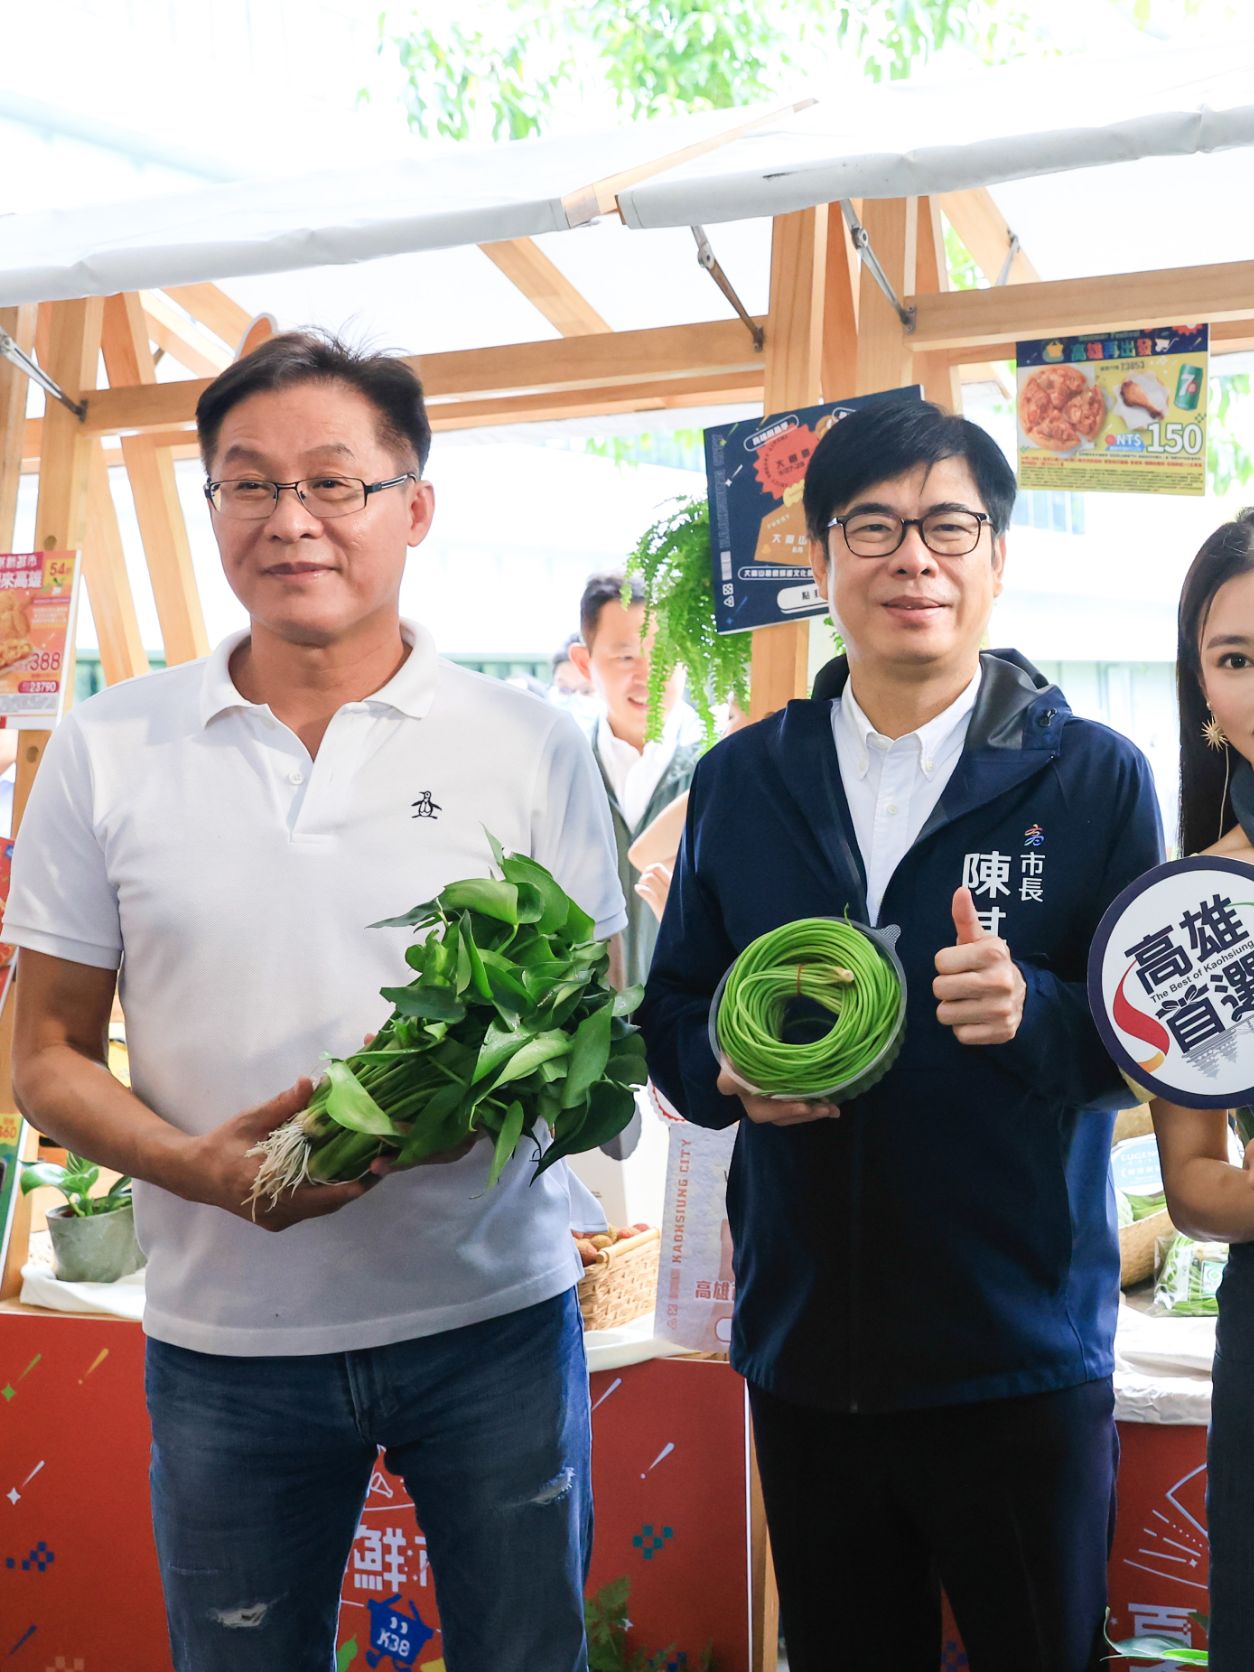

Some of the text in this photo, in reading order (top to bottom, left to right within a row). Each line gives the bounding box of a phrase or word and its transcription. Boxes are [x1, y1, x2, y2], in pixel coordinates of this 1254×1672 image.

[1146, 422, 1203, 455] 150
[30, 652, 61, 672] 388
[1018, 851, 1046, 902] 市長
[1124, 893, 1251, 996] 高雄
[1149, 940, 1254, 1005] The Best of Kaohsiung
[679, 1138, 692, 1174] CITY
[672, 1178, 689, 1264] KAOHSIUNG
[695, 1280, 736, 1301] 高雄
[354, 1524, 427, 1593] 鮮
[376, 1627, 411, 1657] K38
